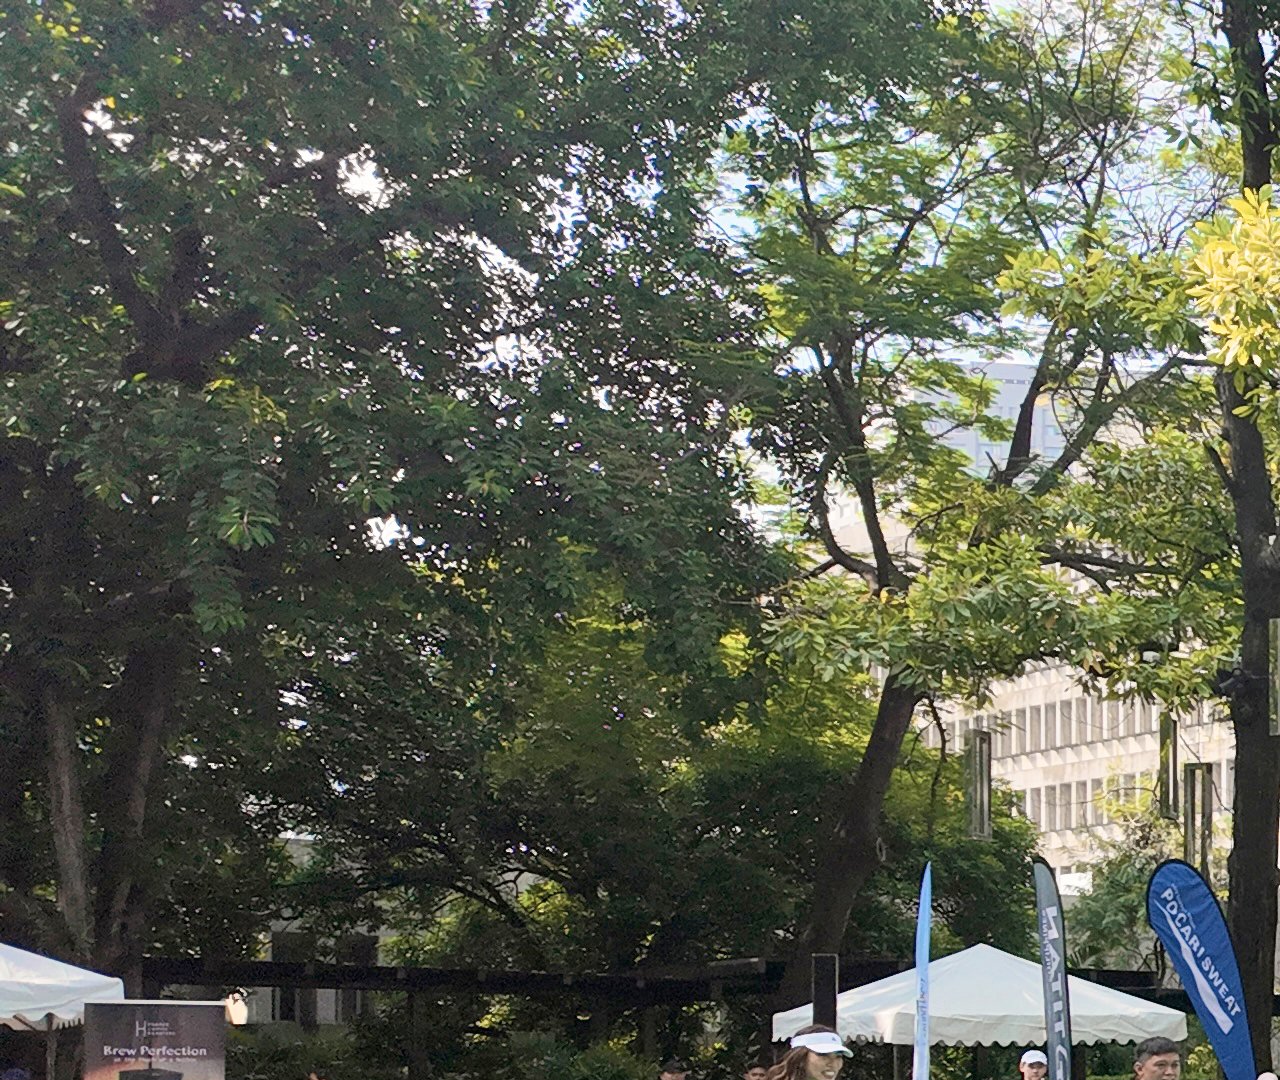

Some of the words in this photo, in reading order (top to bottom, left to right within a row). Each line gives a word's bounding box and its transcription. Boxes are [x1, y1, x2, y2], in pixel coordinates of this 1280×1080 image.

[1160, 887, 1205, 958] POCARI
[1201, 956, 1241, 1017] SWEAT
[103, 1045, 136, 1056] Brew
[140, 1045, 207, 1056] Perfection
